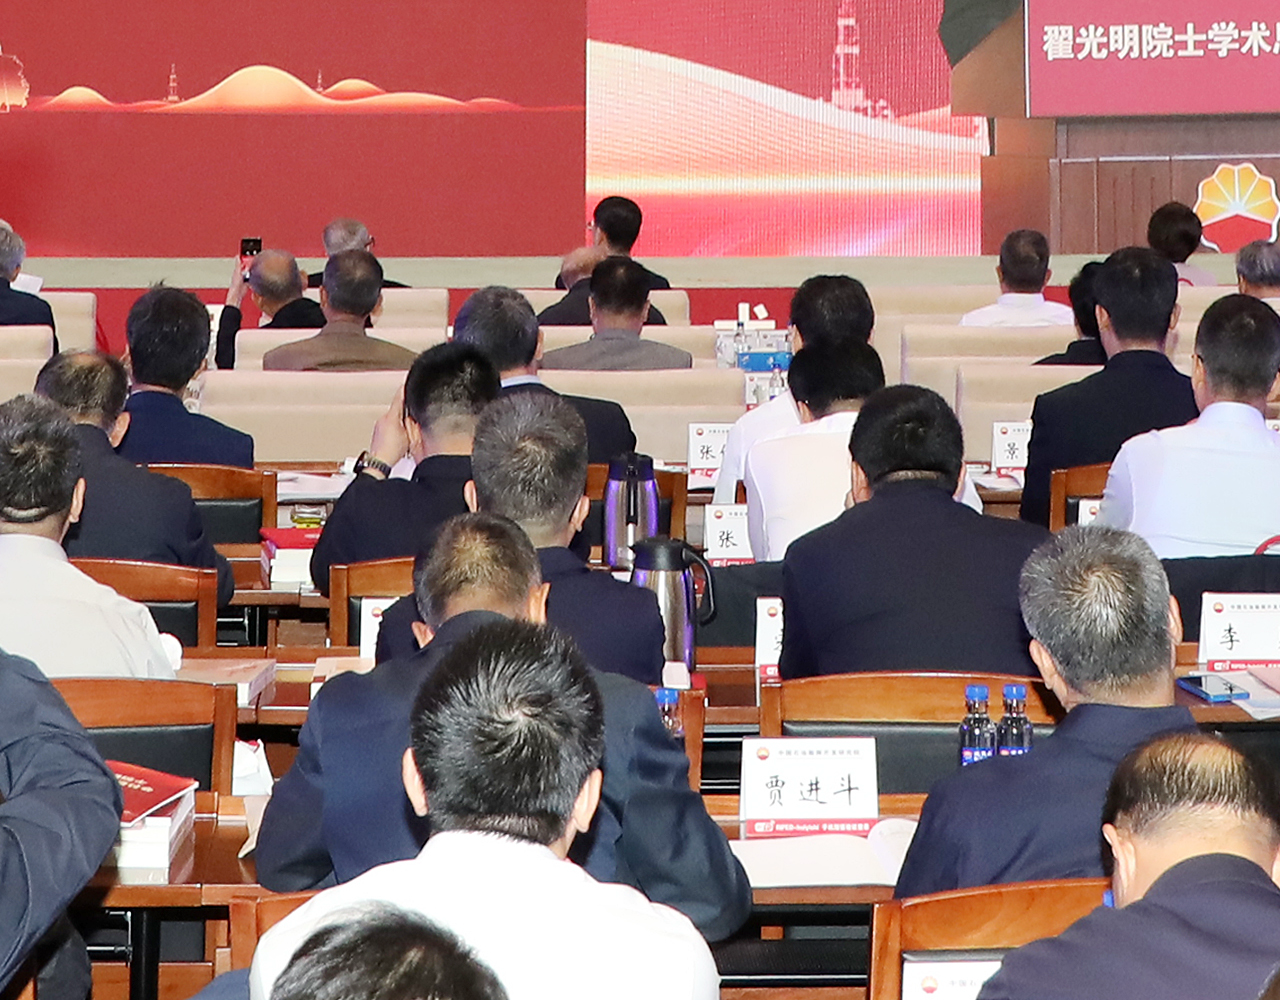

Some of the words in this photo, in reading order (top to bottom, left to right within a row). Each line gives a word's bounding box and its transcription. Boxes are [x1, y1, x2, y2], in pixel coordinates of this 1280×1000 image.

[719, 530, 738, 548] 张
[765, 773, 859, 807] 贾进斗
